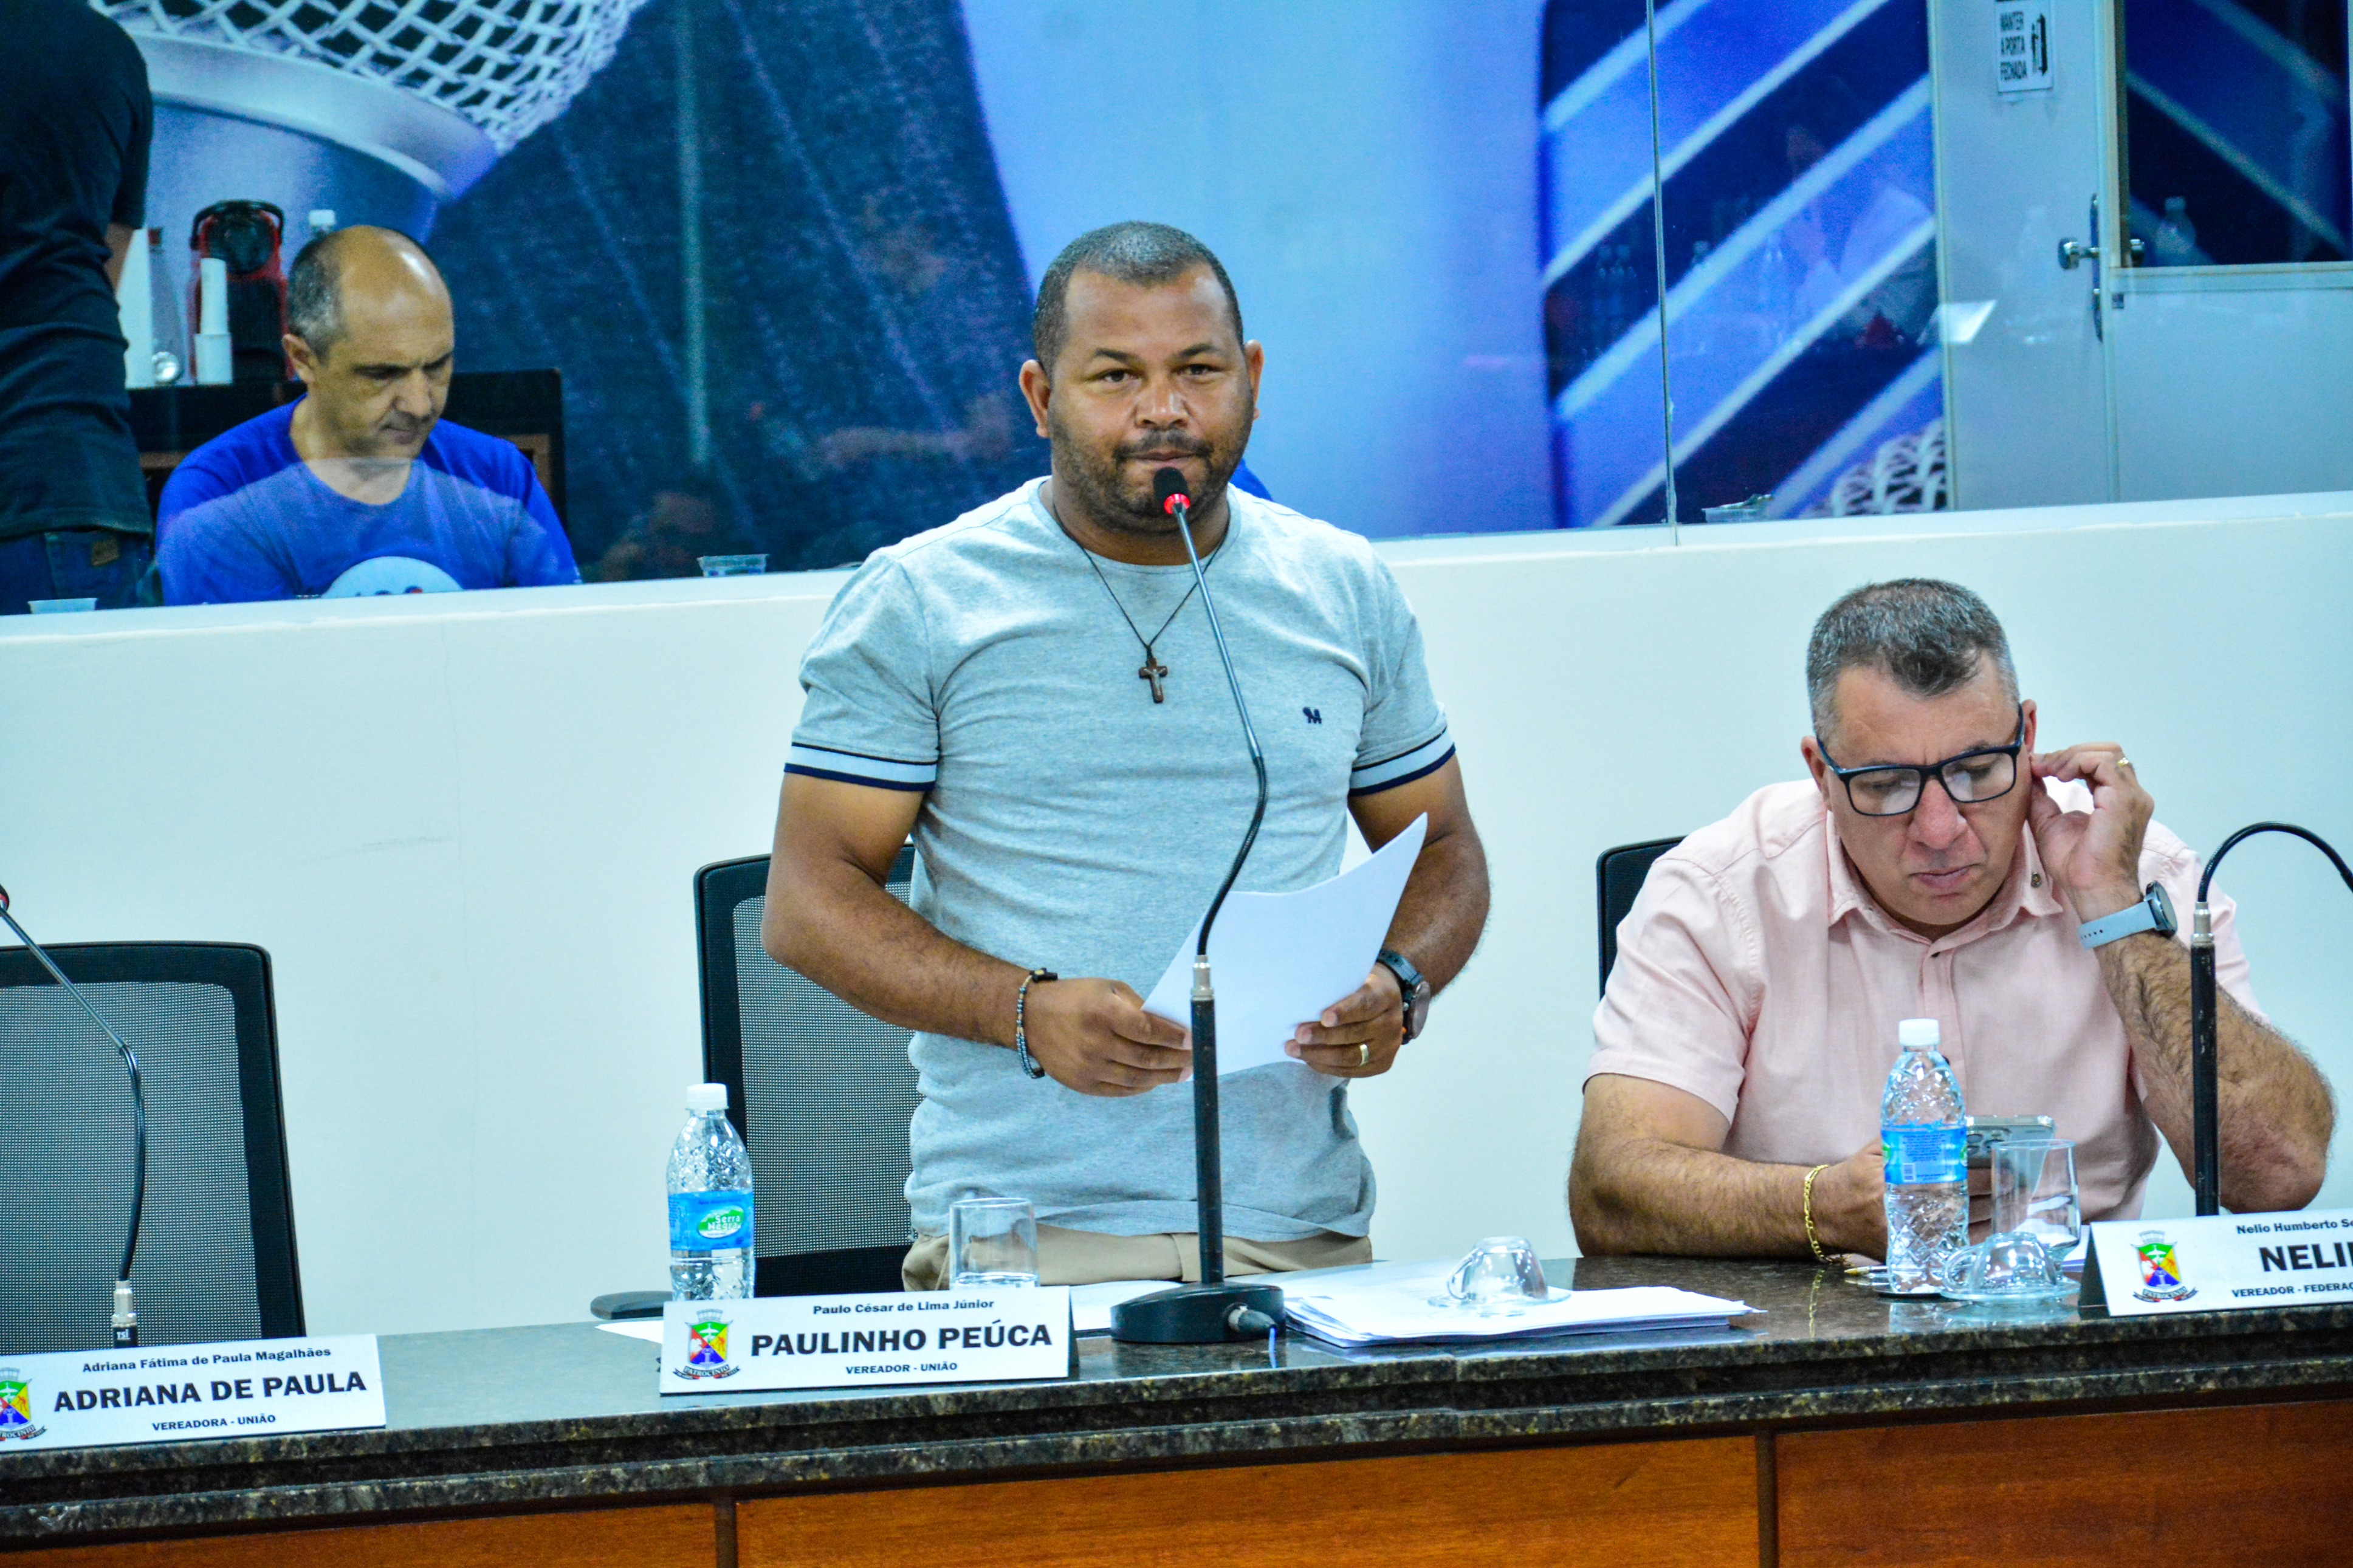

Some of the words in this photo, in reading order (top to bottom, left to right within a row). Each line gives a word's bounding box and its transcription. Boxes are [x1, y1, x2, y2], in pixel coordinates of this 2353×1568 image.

[2000, 11, 2024, 30] MANTER
[2001, 37, 2005, 55] A
[2006, 35, 2025, 55] PORTA
[2001, 61, 2027, 80] FECHADA
[707, 1222, 740, 1231] Negra
[715, 1215, 741, 1224] Serra
[2236, 1224, 2270, 1234] Nelio
[2273, 1220, 2338, 1232] Humberto
[2232, 1286, 2295, 1298] VEREADOR
[813, 1305, 851, 1315] Paulo
[855, 1303, 895, 1313] César
[898, 1303, 913, 1312] de
[918, 1301, 949, 1311] Lima
[953, 1299, 994, 1310] Júnior
[751, 1329, 927, 1357] PAULINHO
[938, 1319, 1052, 1349] PEÚCA
[83, 1361, 136, 1372] Adriana
[140, 1357, 188, 1369] Fátima
[191, 1356, 208, 1365] de
[213, 1353, 252, 1364] Paula
[256, 1349, 331, 1361] Magalhães
[846, 1364, 910, 1375] VEREADOR
[921, 1361, 957, 1372] UNIÃO
[53, 1383, 202, 1412] ADRIANA
[210, 1378, 253, 1401] DE
[263, 1371, 367, 1397] PAULA
[152, 1418, 227, 1431] VEREADORA
[238, 1413, 276, 1425] UNIÃO
